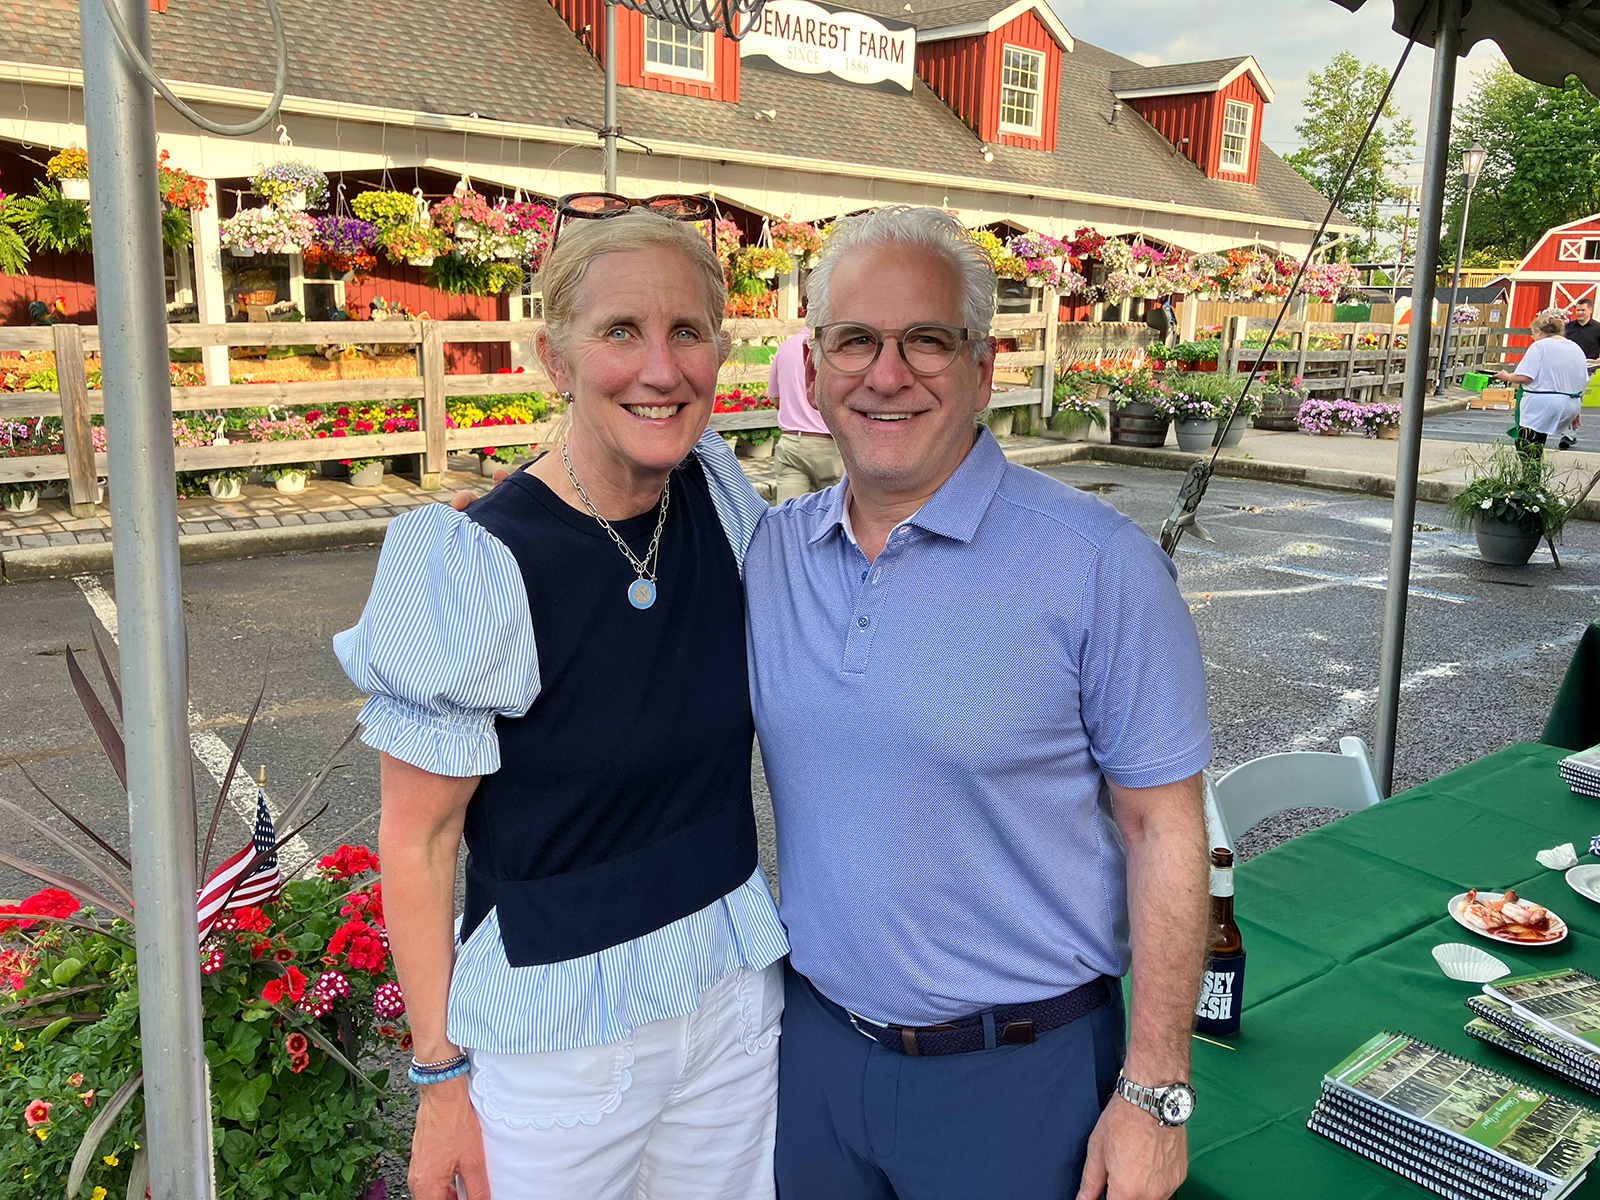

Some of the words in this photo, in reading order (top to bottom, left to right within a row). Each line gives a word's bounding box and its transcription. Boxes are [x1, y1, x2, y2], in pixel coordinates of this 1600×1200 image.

[749, 8, 851, 52] DEMAREST
[859, 30, 904, 64] FARM
[787, 45, 820, 65] SINCE
[845, 57, 869, 74] 1886
[1203, 970, 1235, 994] SEY
[1195, 996, 1232, 1020] ESH
